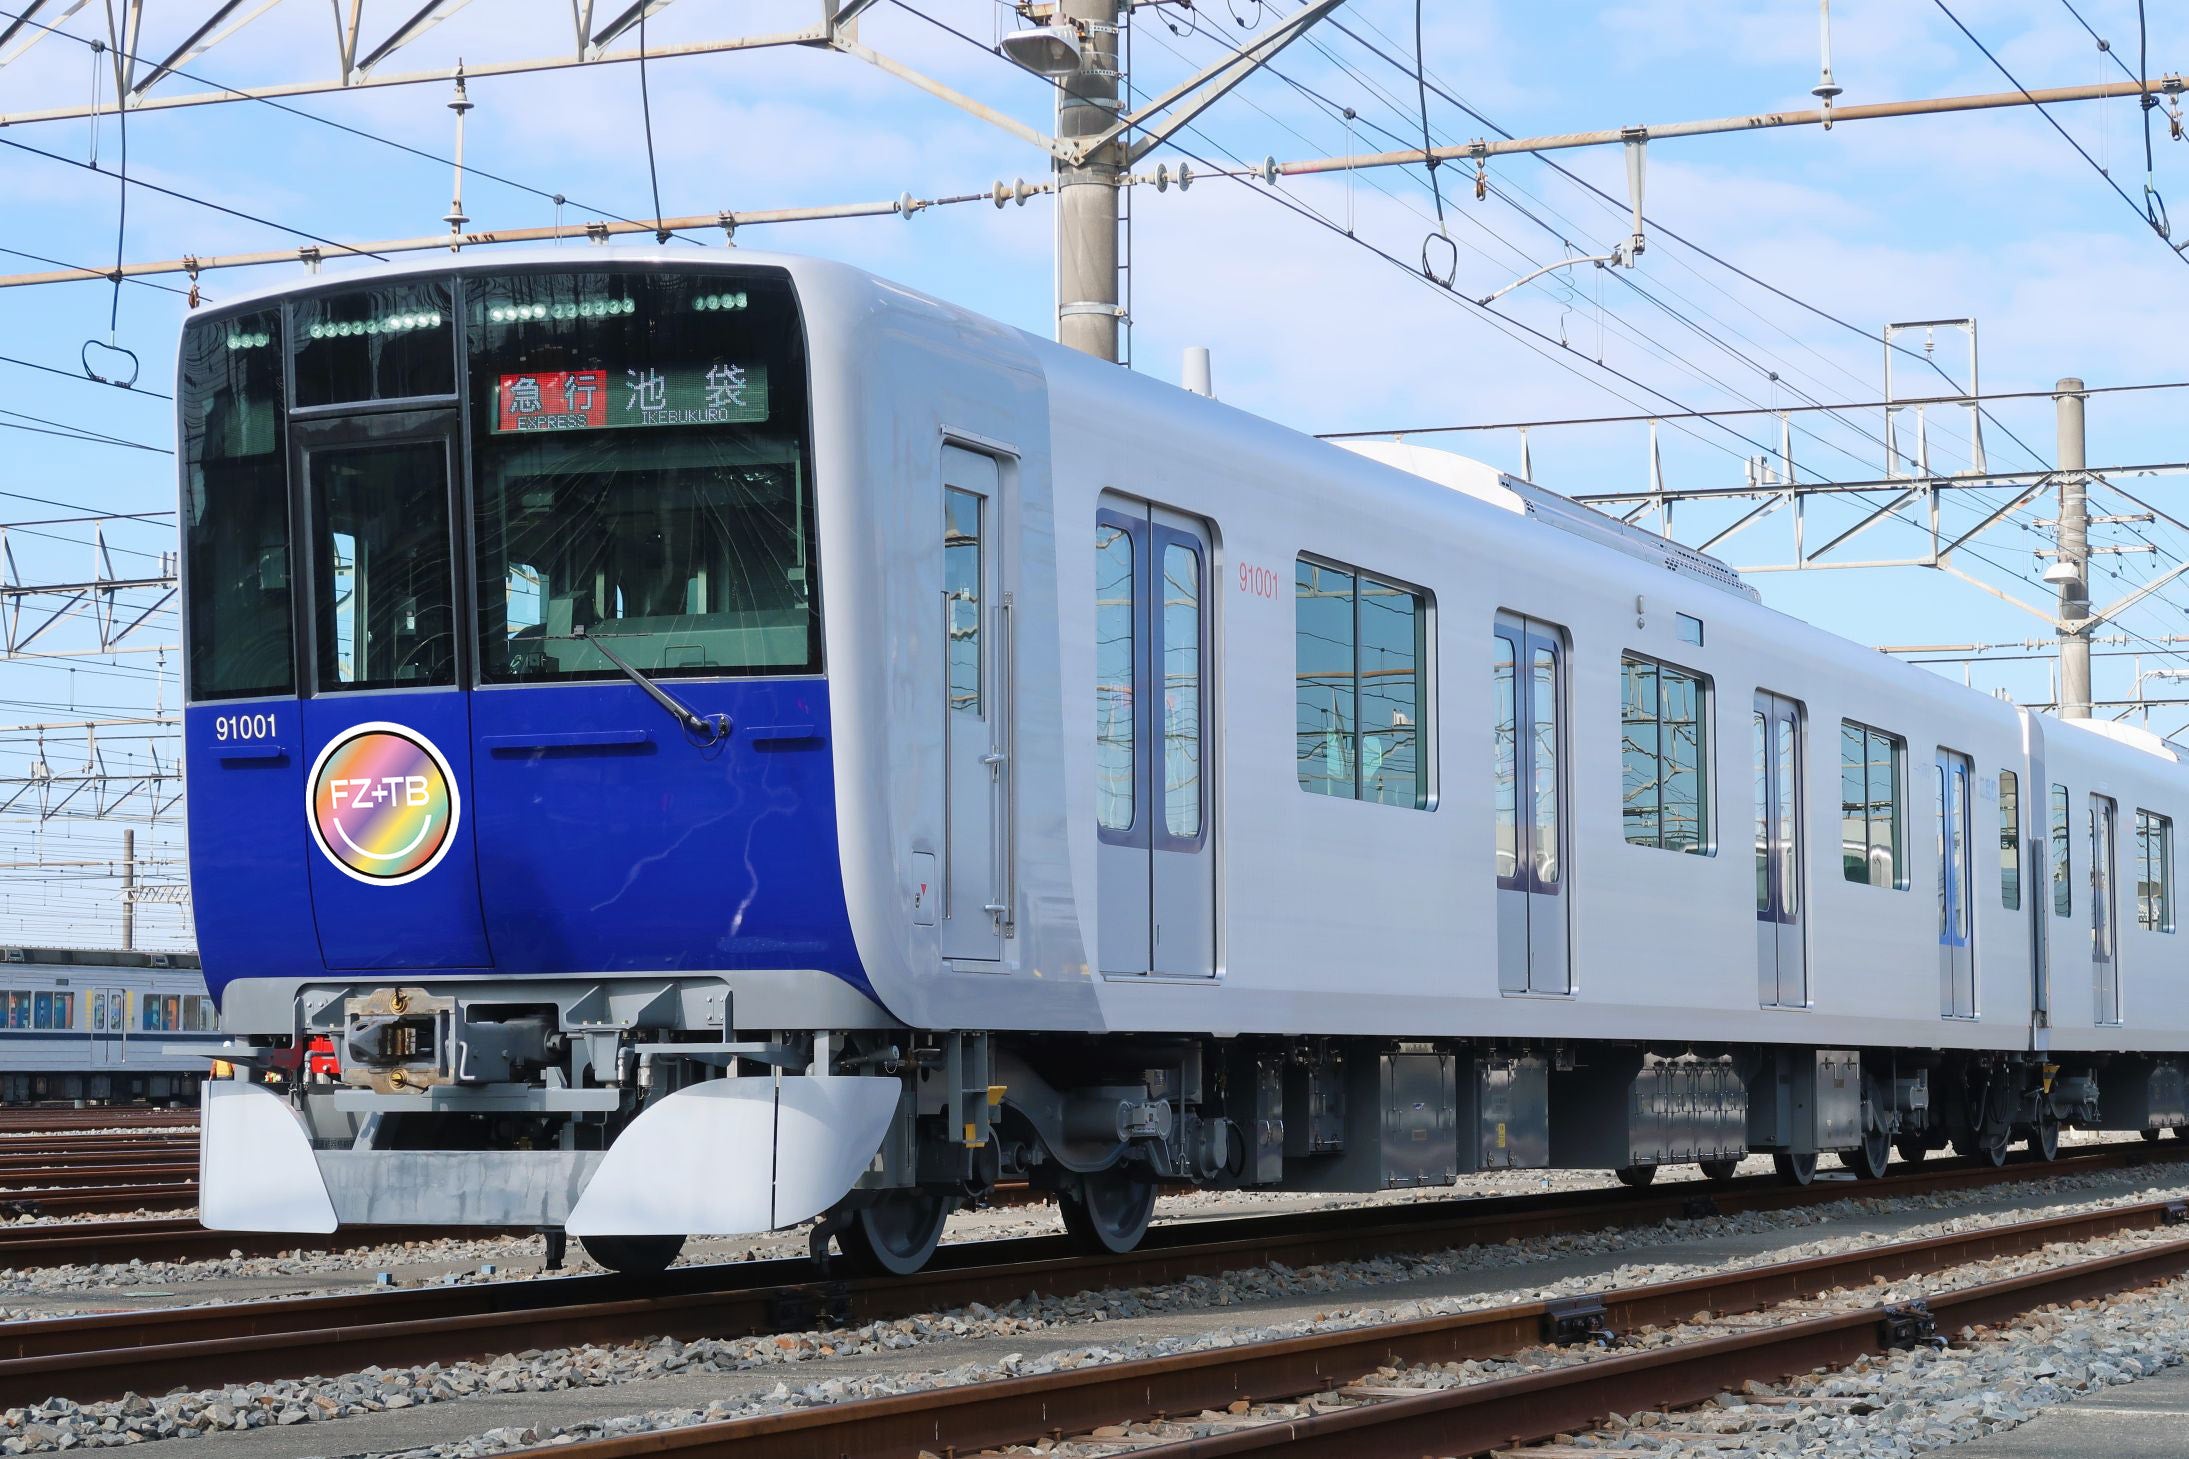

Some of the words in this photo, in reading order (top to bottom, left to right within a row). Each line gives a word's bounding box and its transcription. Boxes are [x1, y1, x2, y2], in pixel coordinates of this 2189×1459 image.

[510, 374, 597, 413] 急行
[626, 364, 747, 411] 池袋
[517, 414, 588, 430] EXPRESS
[641, 408, 728, 425] IKEBUKURO
[1239, 561, 1278, 601] 91001
[215, 713, 277, 741] 91001
[329, 775, 431, 810] FZ+TB
